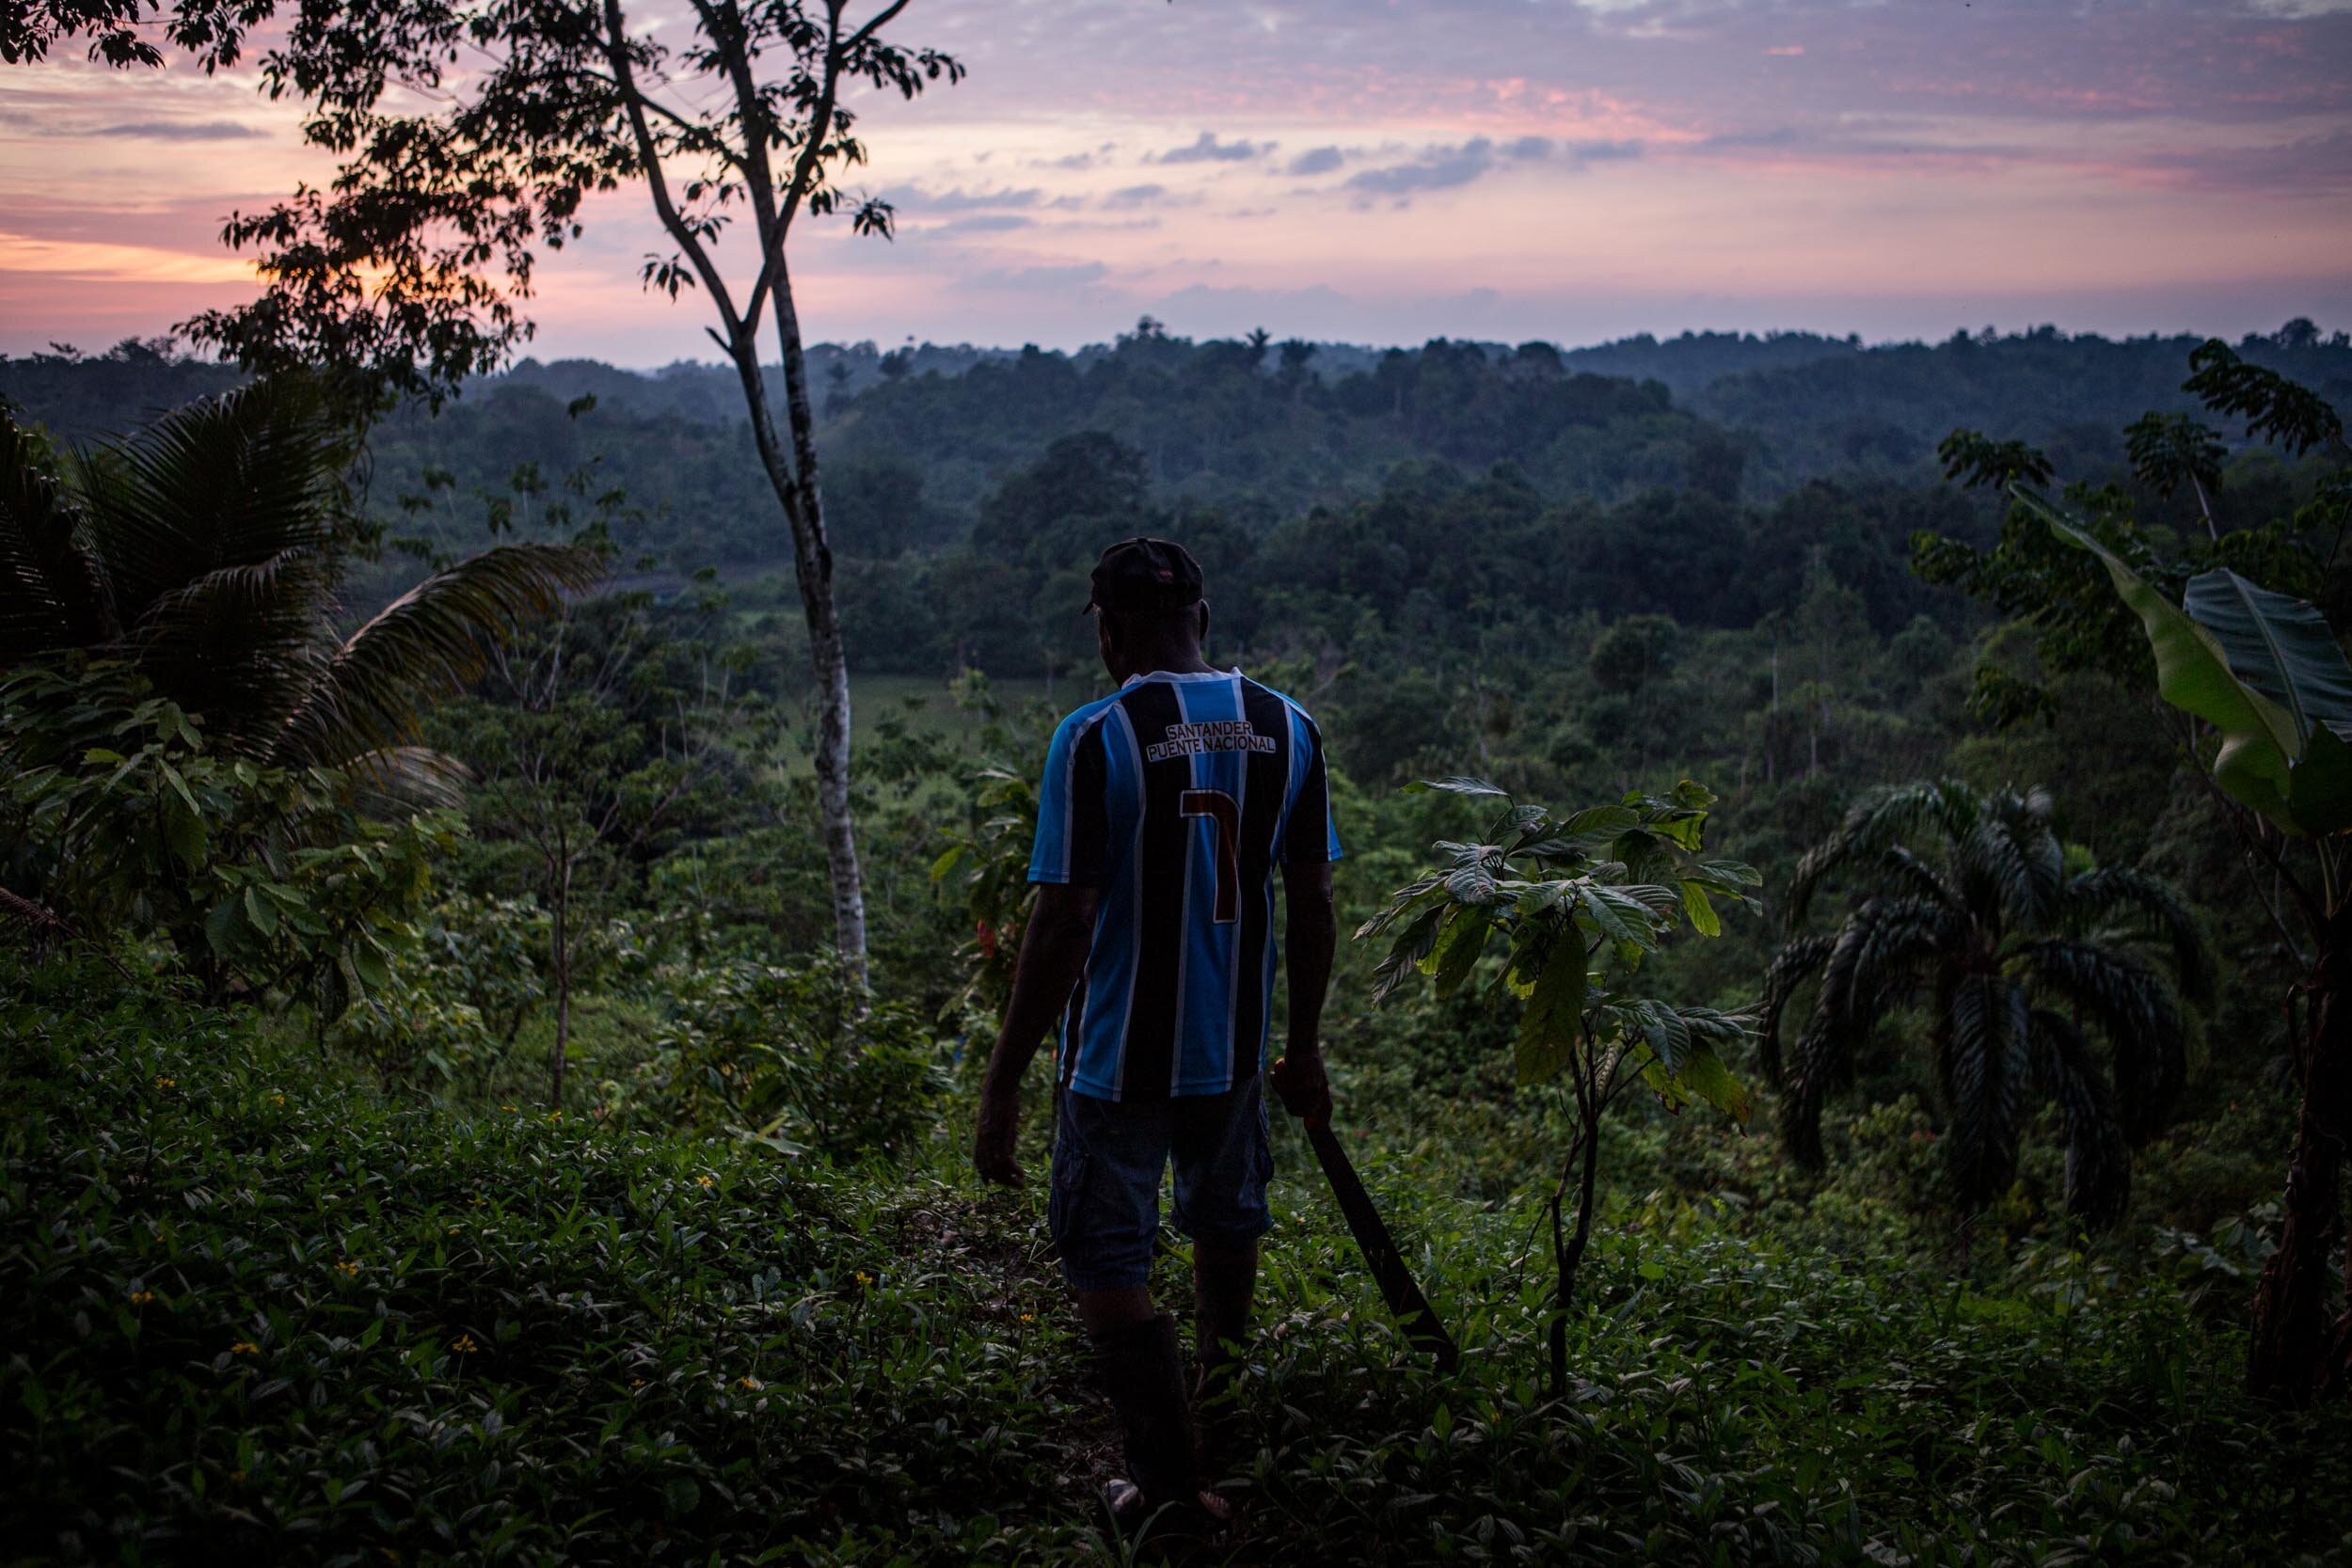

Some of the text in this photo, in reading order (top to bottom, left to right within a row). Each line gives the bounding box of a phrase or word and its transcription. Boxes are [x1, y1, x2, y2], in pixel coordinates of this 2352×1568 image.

[1168, 721, 1252, 741] SANTANDER
[1149, 736, 1275, 760] PUENTE NACIONAL
[1180, 789, 1242, 925] 7
